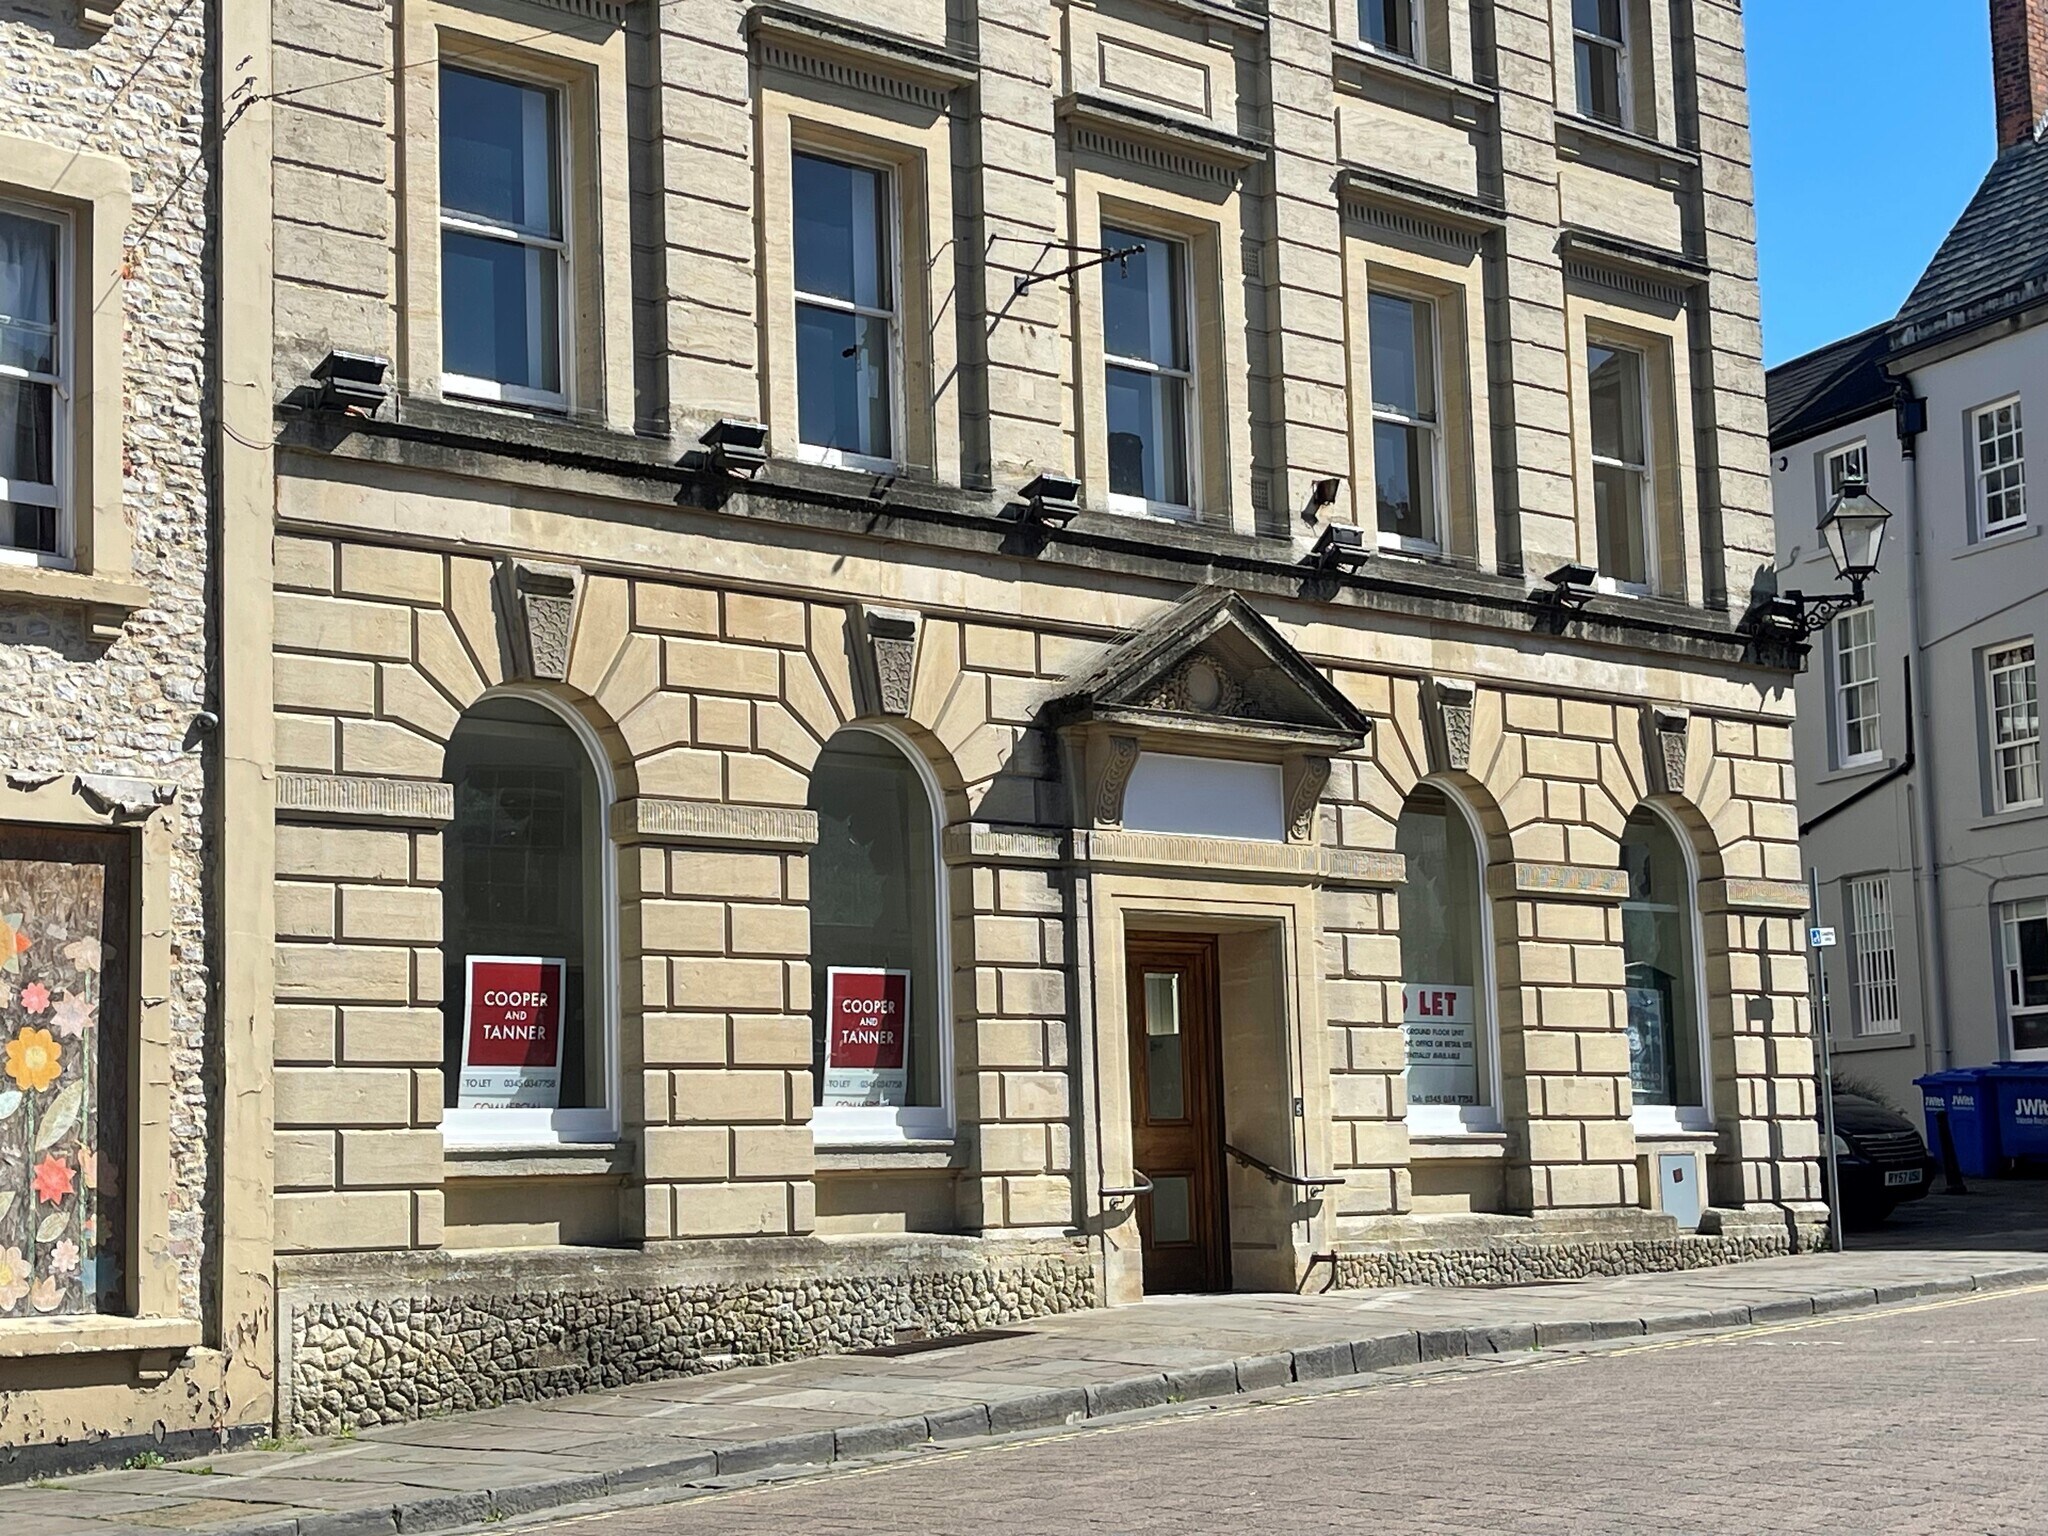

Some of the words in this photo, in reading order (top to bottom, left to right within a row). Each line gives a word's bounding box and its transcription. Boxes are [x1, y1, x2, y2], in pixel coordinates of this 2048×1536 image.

[484, 990, 548, 1006] COOPER
[1418, 991, 1456, 1016] LET
[842, 999, 895, 1014] COOPER
[505, 1011, 527, 1021] AND
[859, 1017, 878, 1027] AND
[483, 1024, 546, 1040] TANNER
[842, 1030, 894, 1044] TANNER
[1406, 1028, 1431, 1036] GROUND
[1432, 1028, 1450, 1036] FLOOR
[465, 1079, 478, 1088] TO
[478, 1079, 492, 1088] LET
[829, 1080, 839, 1088] TO
[839, 1080, 851, 1088] LET
